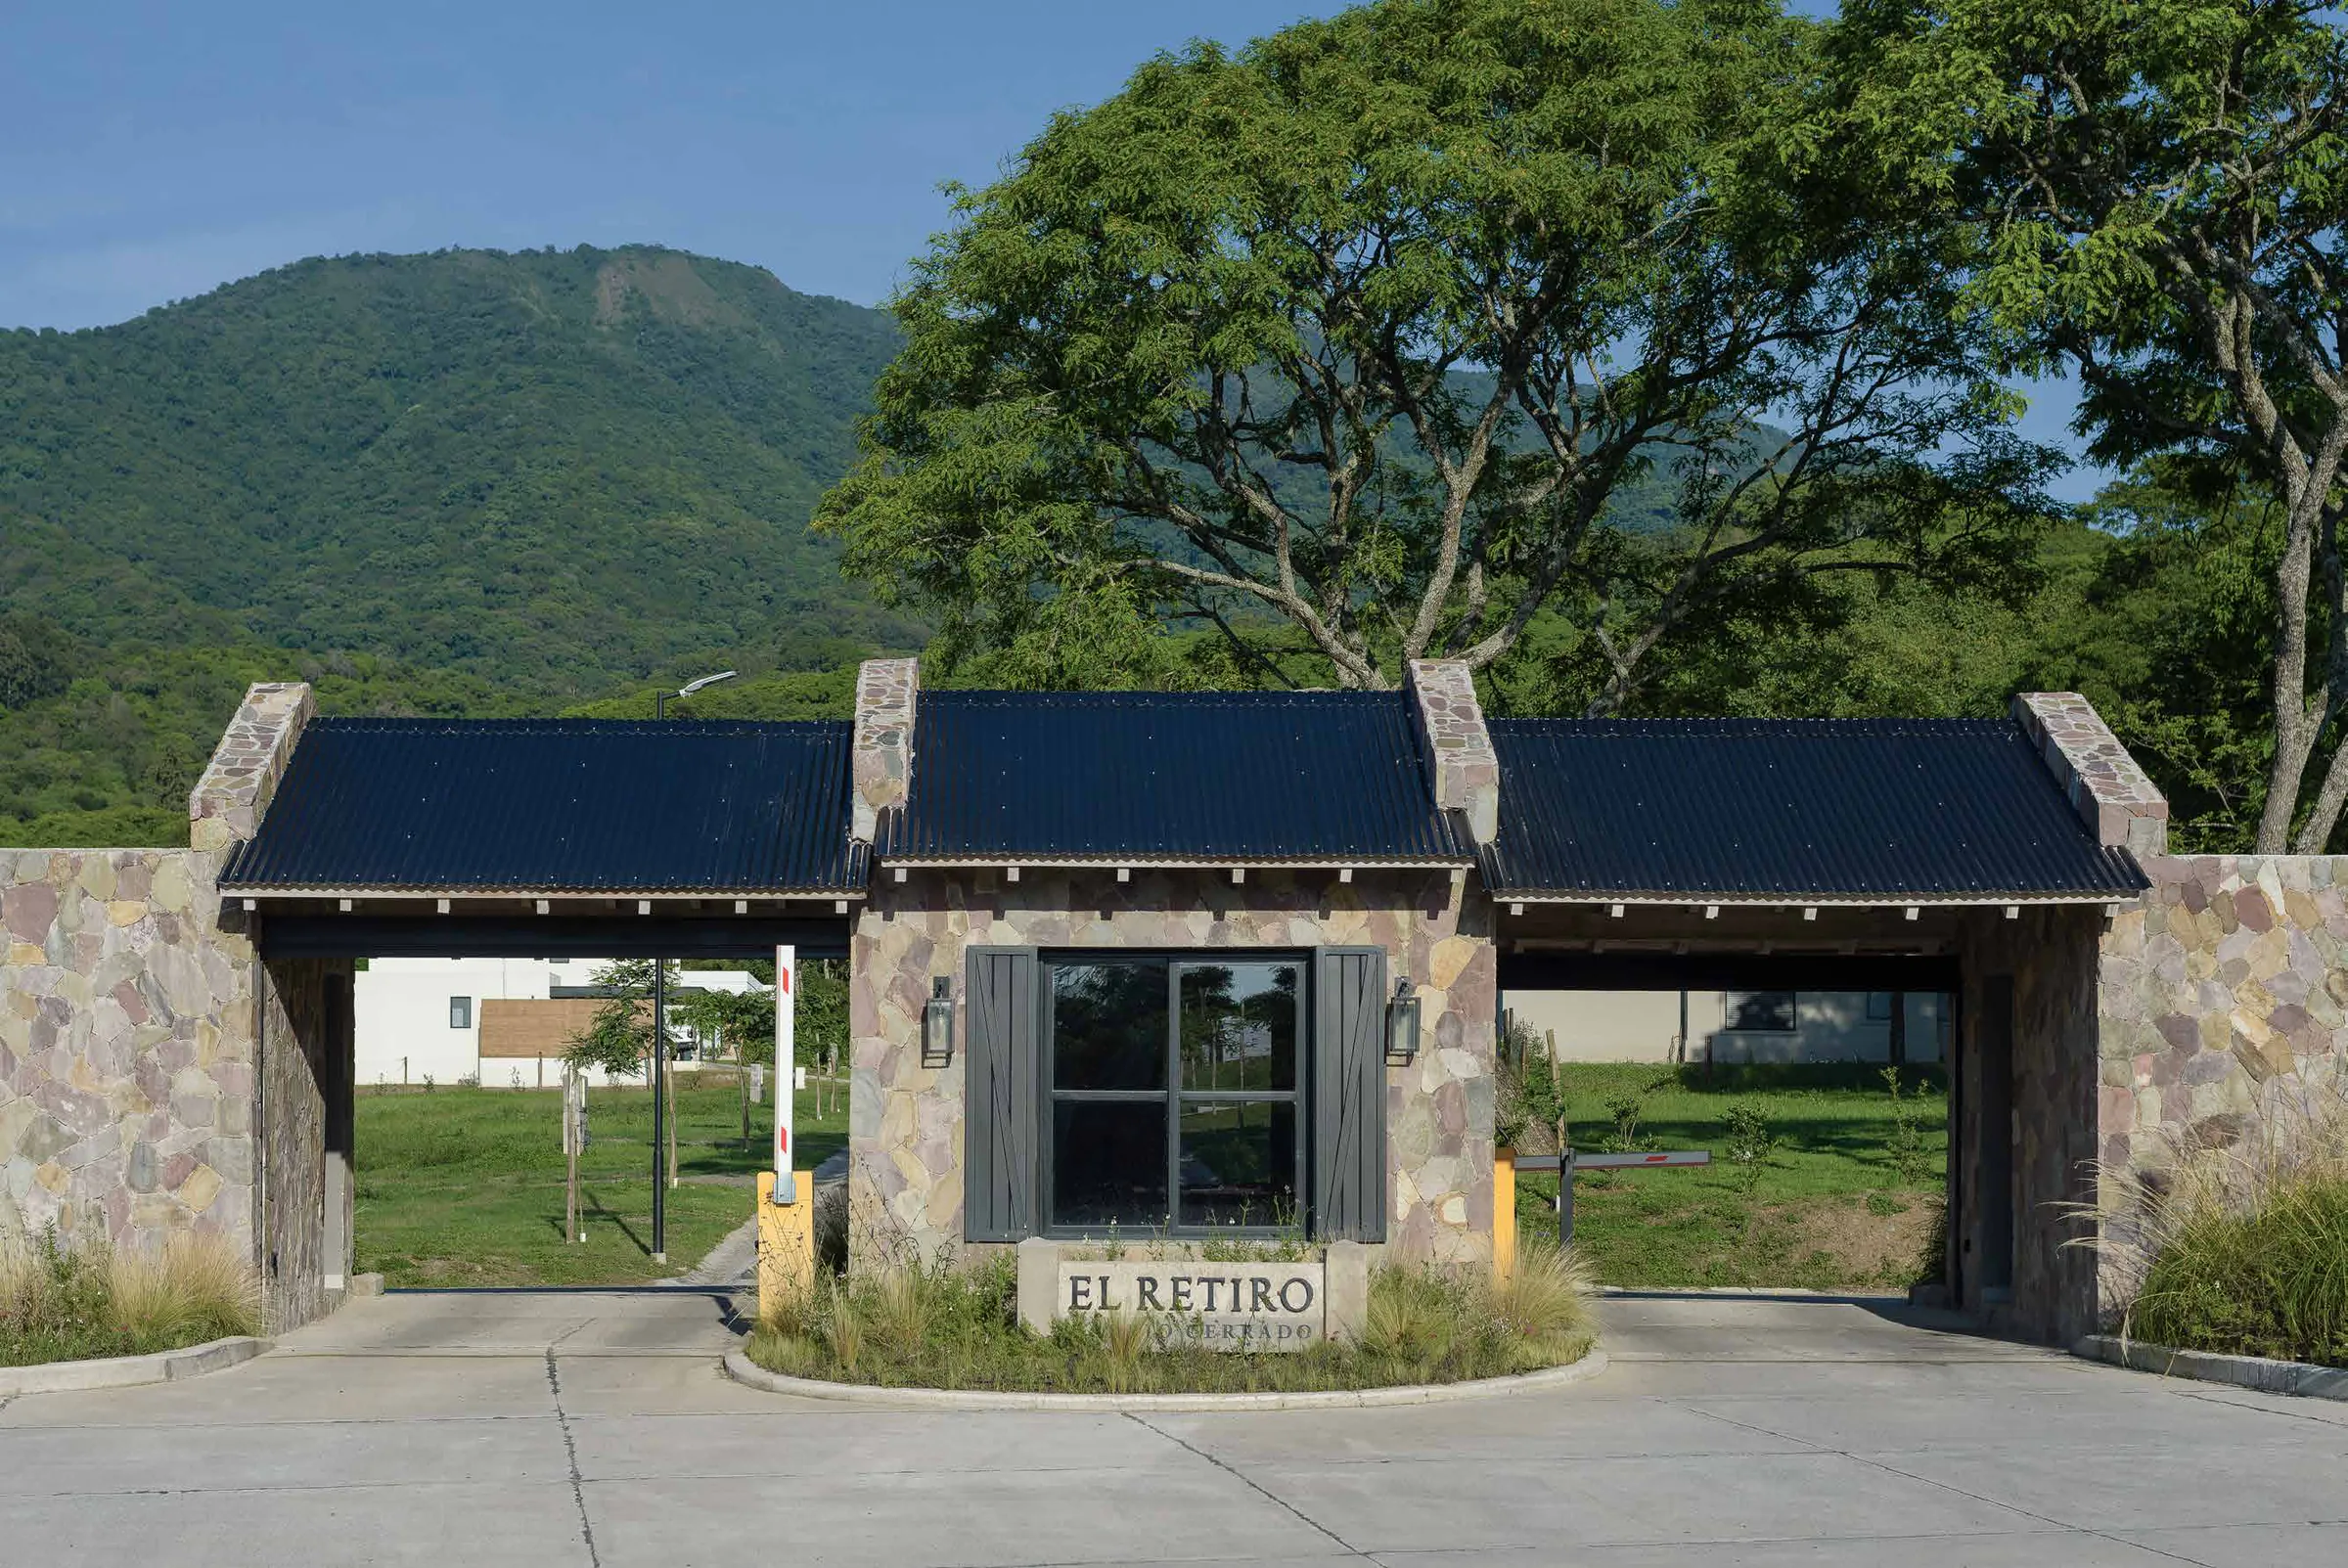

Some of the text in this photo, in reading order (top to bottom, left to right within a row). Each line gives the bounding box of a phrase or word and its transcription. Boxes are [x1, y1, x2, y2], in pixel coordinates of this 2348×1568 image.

[1067, 1275, 1314, 1314] EL RETIRO
[1186, 1323, 1312, 1340] CERRADO
